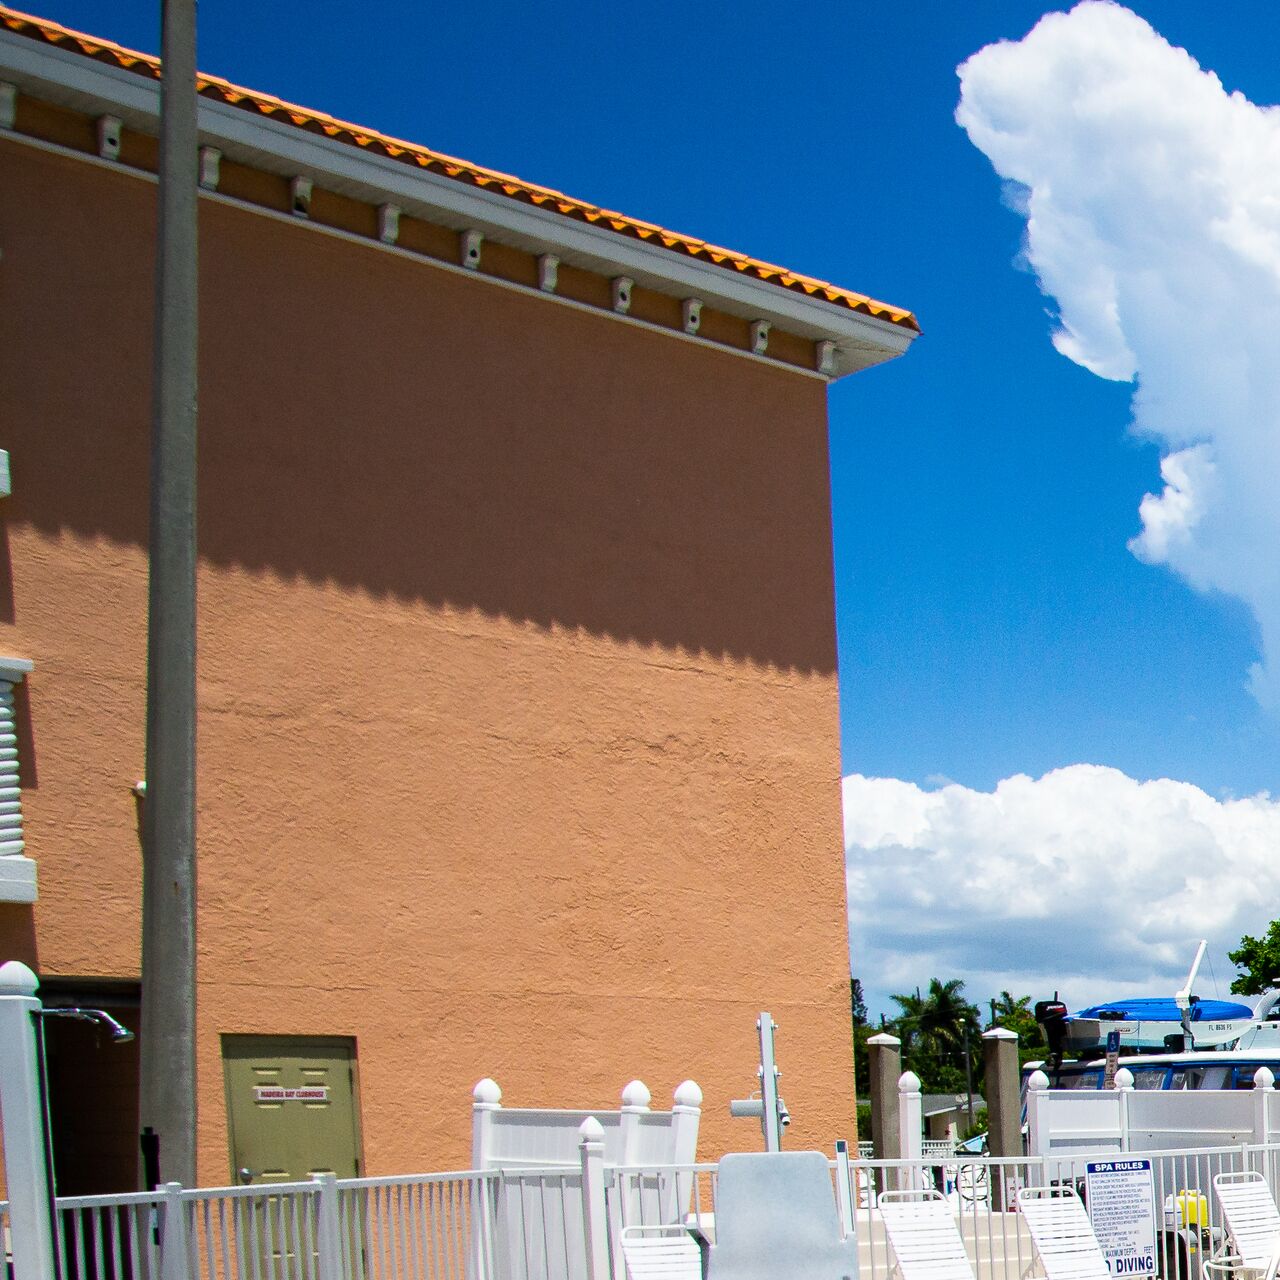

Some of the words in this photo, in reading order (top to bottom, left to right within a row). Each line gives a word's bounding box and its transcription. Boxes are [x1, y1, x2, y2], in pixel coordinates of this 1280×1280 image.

[1095, 1163, 1113, 1172] SPA
[1114, 1161, 1144, 1171] RULES
[1115, 1255, 1154, 1274] DIVING
